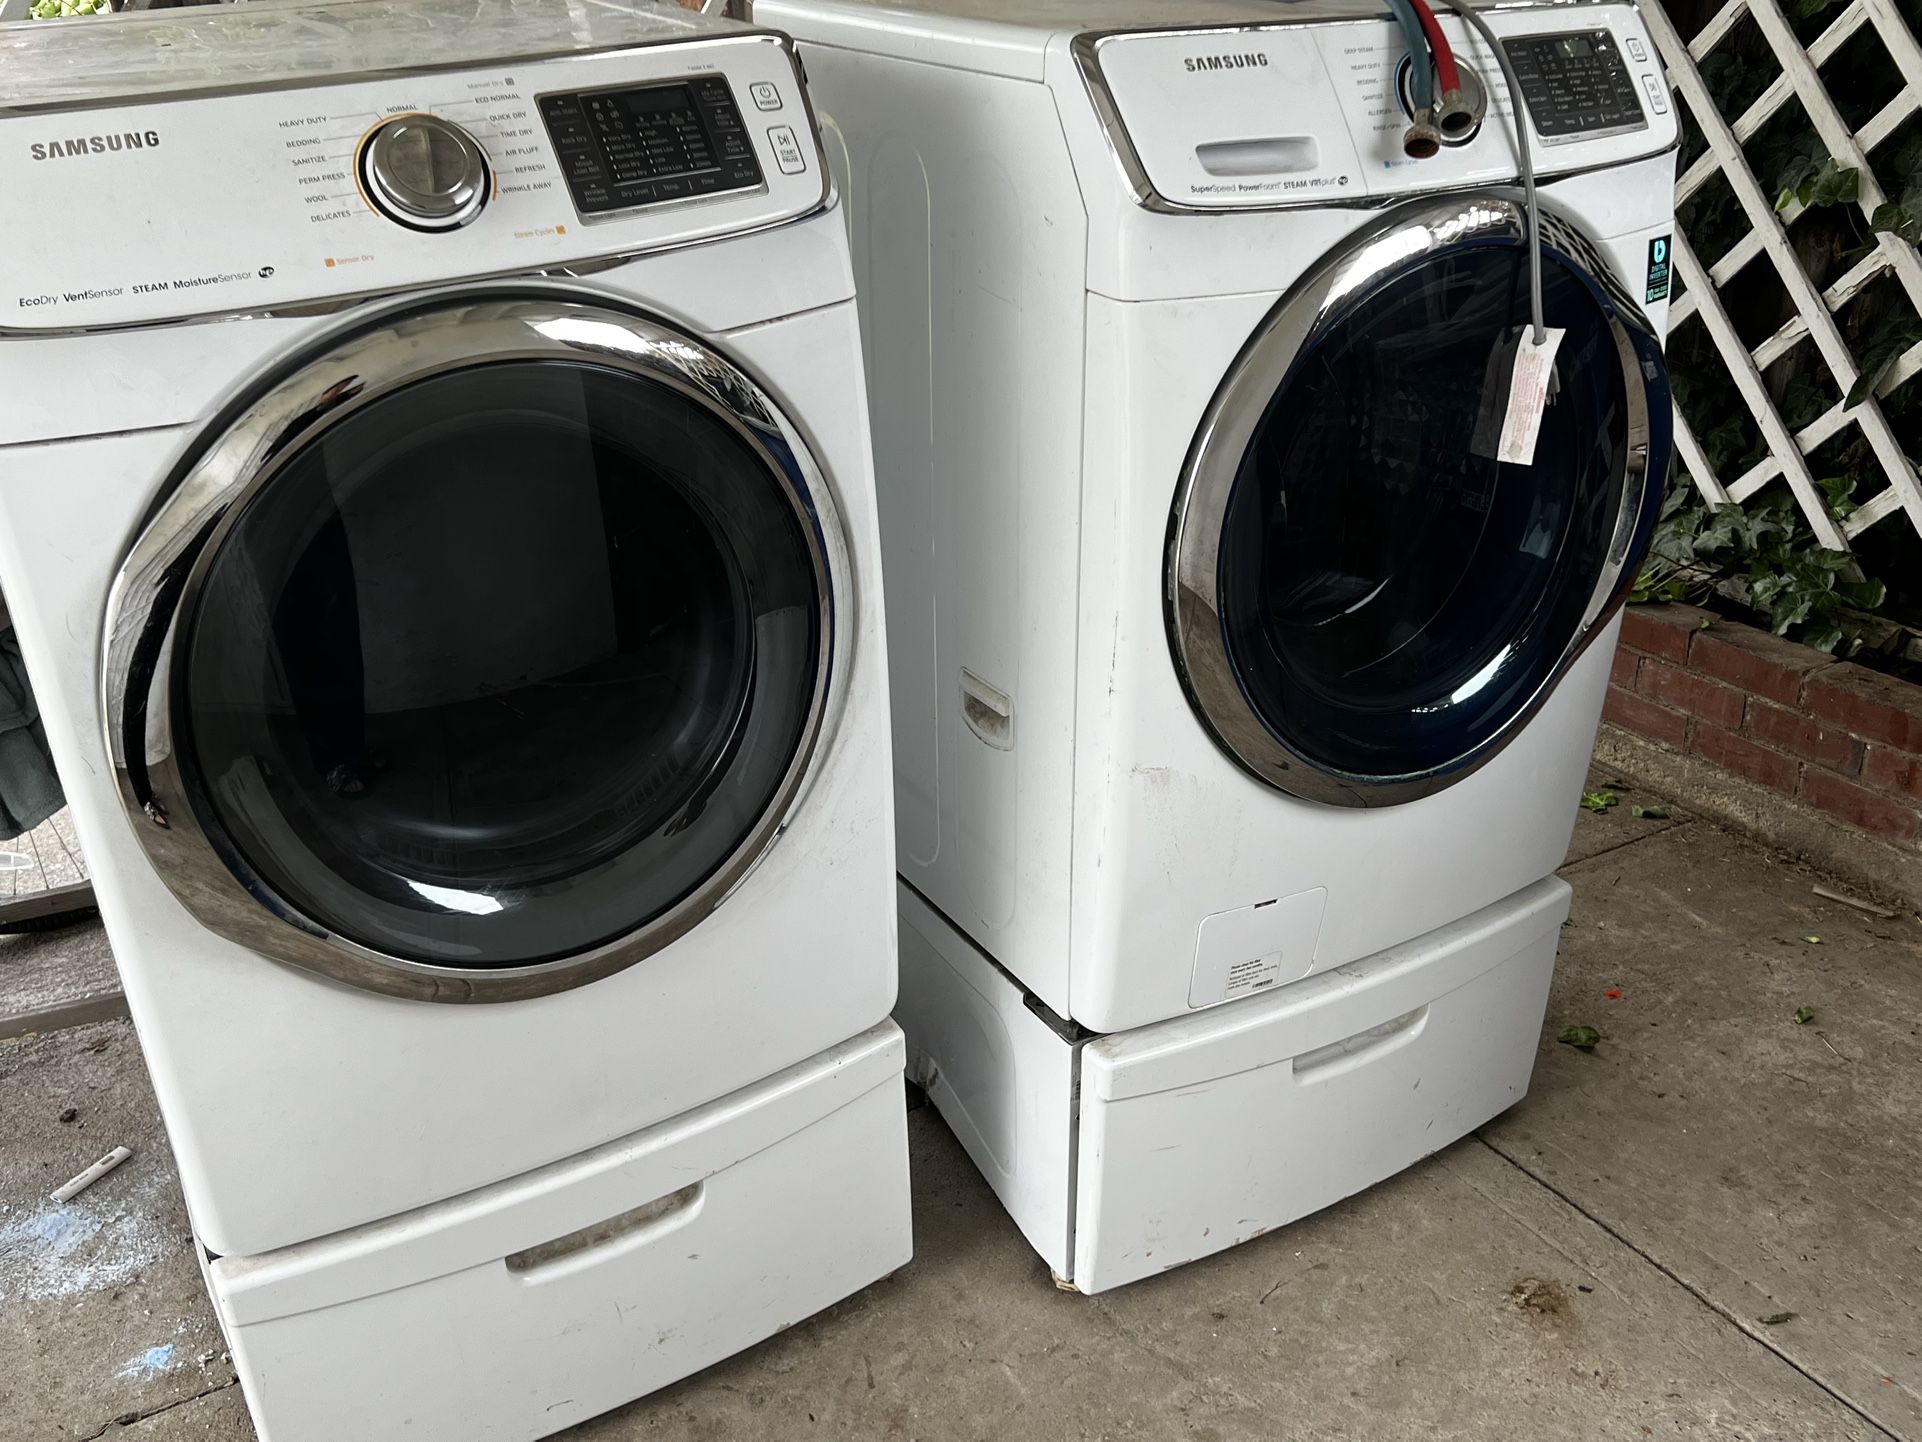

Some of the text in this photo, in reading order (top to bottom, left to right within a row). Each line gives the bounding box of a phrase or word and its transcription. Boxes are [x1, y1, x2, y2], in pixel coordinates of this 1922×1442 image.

[1184, 53, 1268, 72] SAMSUNG
[475, 93, 521, 104] ECO NORMAL
[386, 104, 419, 113] NORMAL
[279, 115, 328, 128] HEAVY DUTY
[489, 111, 528, 122] QUICK DRY
[500, 128, 534, 139] TIME DRY
[30, 130, 160, 160] SAMSUNG
[286, 138, 322, 148] BEDDING
[505, 146, 539, 157] AIR FLUFF
[292, 155, 327, 166] SANITIZE
[515, 164, 546, 174] REFRESH
[298, 172, 346, 186] PERM PRESS
[501, 181, 553, 195] WRINKLE AWAY
[1190, 183, 1236, 194] SuperSpeed
[1283, 180, 1308, 189] STEAM
[304, 194, 329, 204] WOOL
[310, 210, 351, 223] DELICATES
[336, 254, 375, 265] Sensor Dry
[19, 293, 59, 308] EcoDry
[63, 285, 125, 303] VentSensor
[131, 280, 169, 294] STEAM
[173, 269, 253, 289] MoistureSensor
